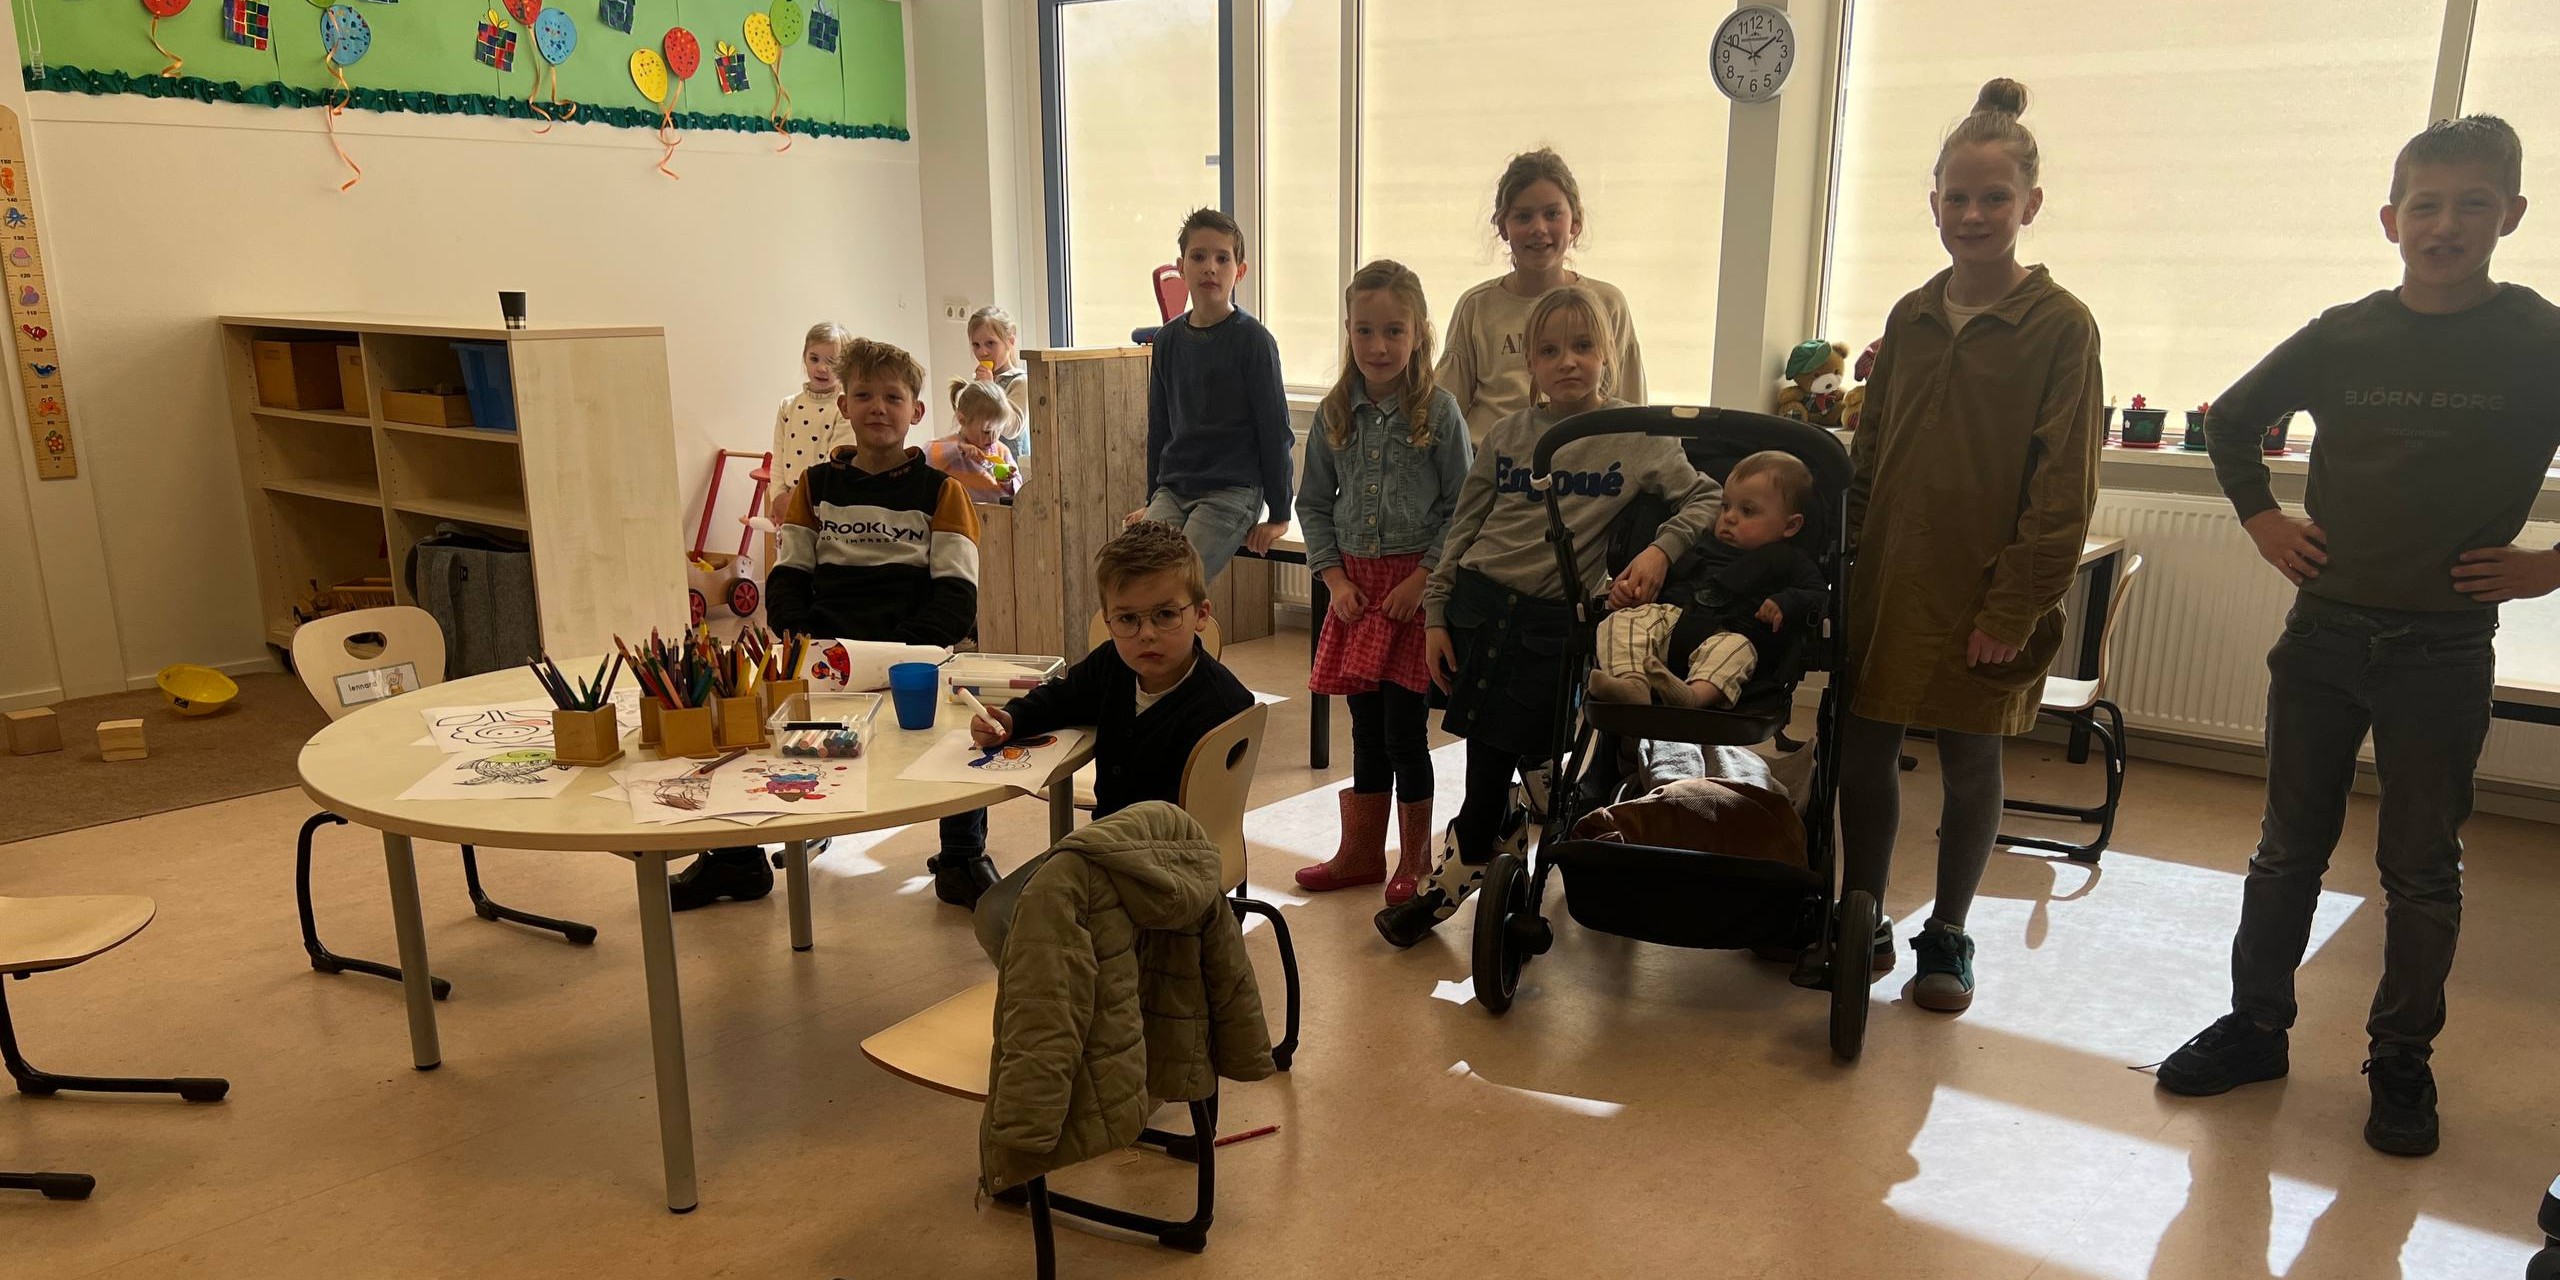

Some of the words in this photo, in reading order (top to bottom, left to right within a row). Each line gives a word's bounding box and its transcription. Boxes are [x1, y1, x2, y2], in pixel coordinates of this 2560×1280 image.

[1739, 21, 1748, 35] 11
[1750, 15, 1764, 30] 12
[1768, 19, 1773, 33] 1
[1728, 33, 1740, 48] 10
[1776, 28, 1784, 43] 2
[1722, 49, 1731, 63] 9
[1780, 44, 1788, 59] 3
[1726, 65, 1735, 79] 8
[1774, 61, 1782, 75] 4
[1737, 75, 1745, 89] 7
[1749, 79, 1758, 93] 6
[1763, 73, 1772, 88] 5
[2345, 386, 2423, 406] BJÖRN
[2431, 392, 2505, 410] BORG
